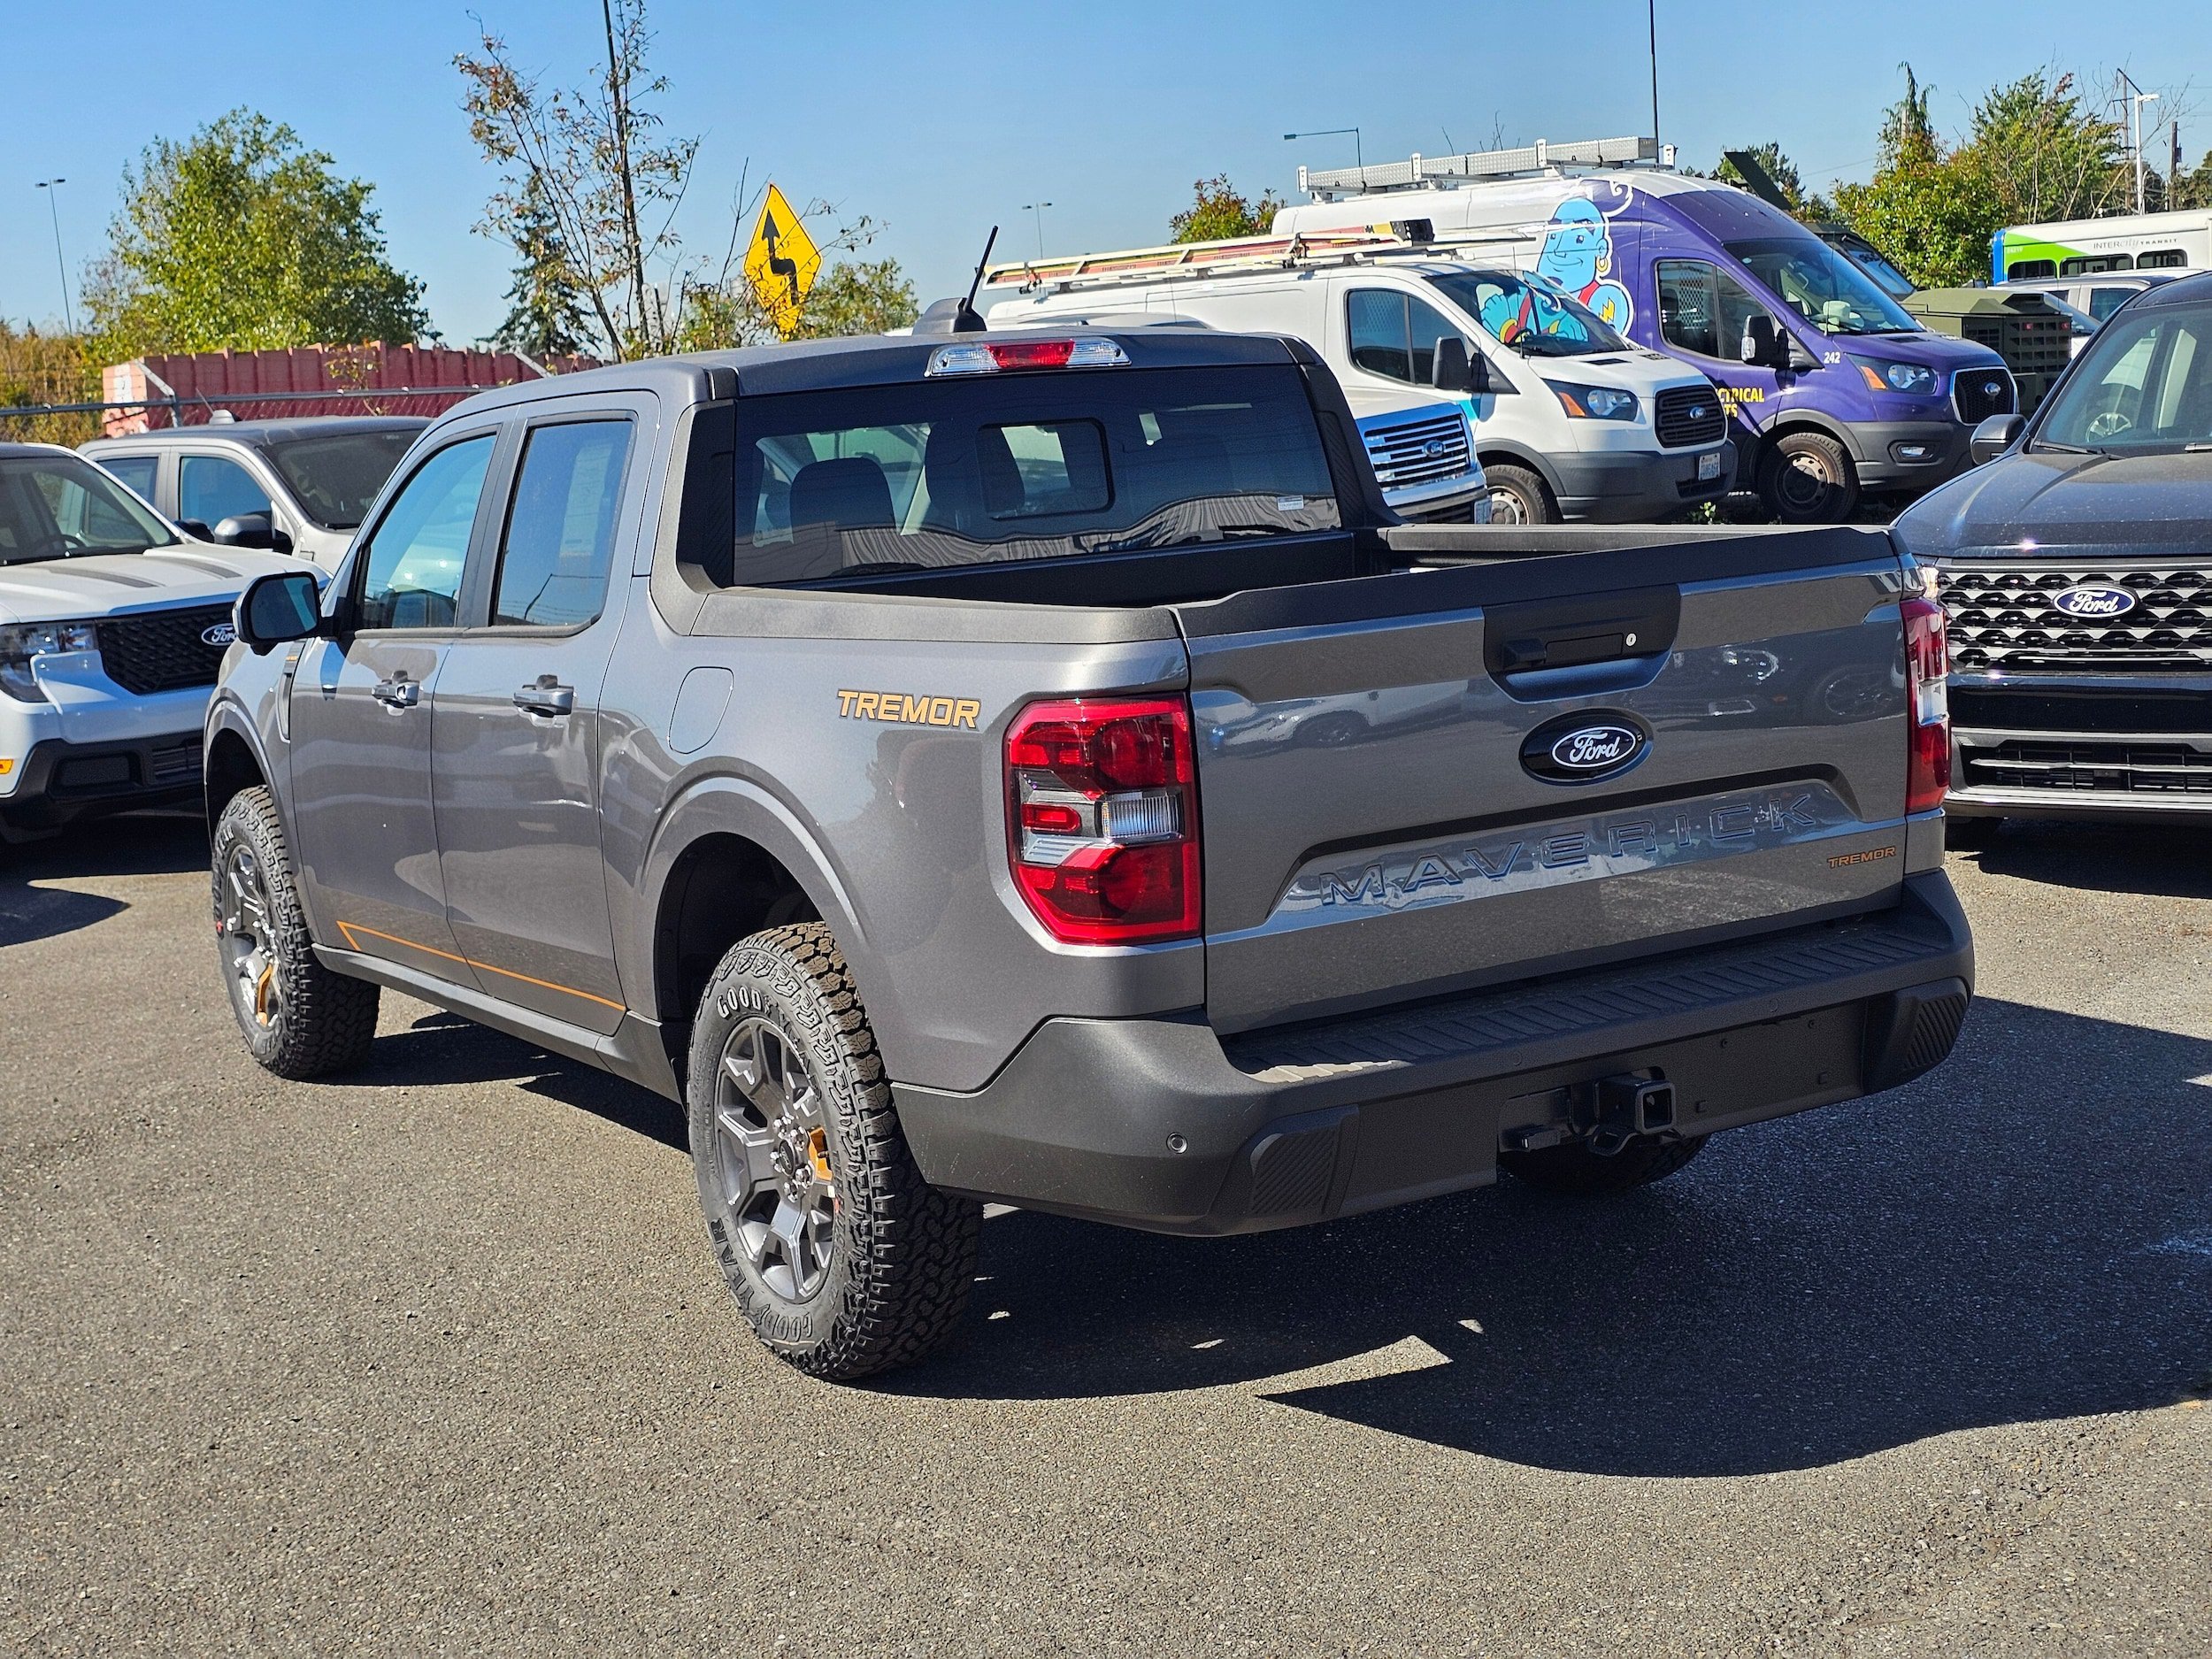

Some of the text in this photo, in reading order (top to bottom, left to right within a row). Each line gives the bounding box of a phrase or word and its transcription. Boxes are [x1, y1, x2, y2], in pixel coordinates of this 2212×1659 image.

[1824, 351, 1841, 364] 242
[1716, 387, 1765, 403] CTRICAL
[2070, 590, 2118, 612] Ford
[837, 689, 982, 729] TREMOR
[1569, 732, 1621, 763] Ford
[1319, 794, 1816, 906] MAVERICK
[1827, 846, 1897, 869] TREMOR
